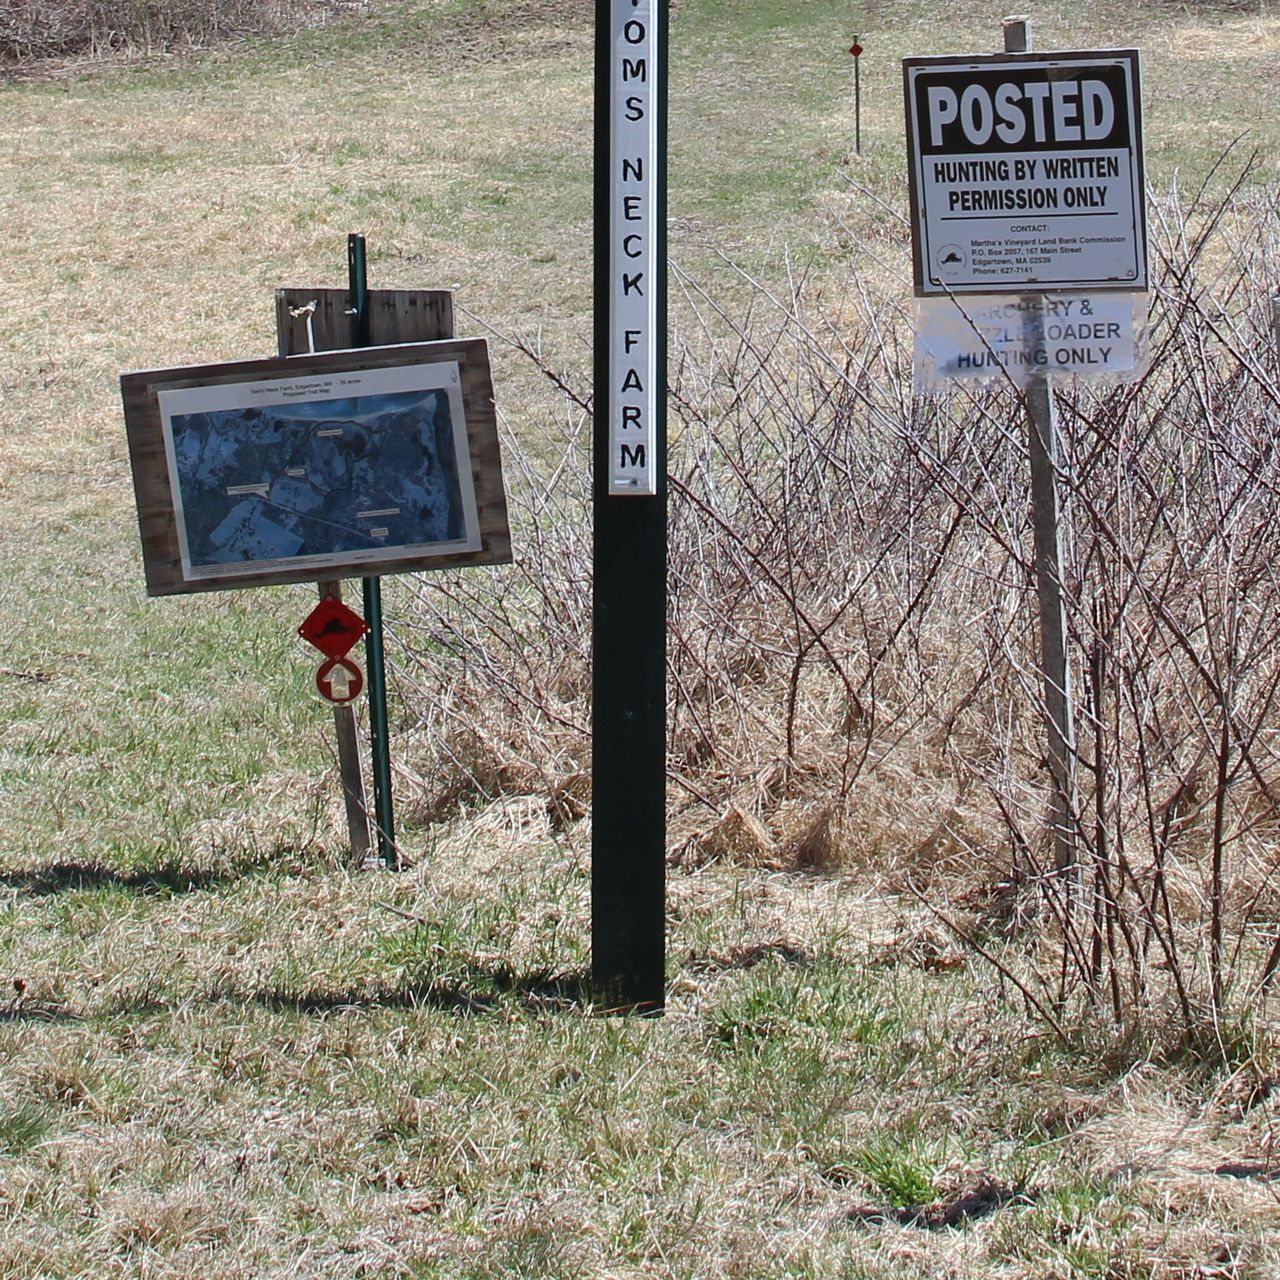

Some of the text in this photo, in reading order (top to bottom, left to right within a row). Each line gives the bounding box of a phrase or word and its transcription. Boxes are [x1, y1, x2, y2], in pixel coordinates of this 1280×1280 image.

[928, 80, 1114, 146] POSTED
[934, 156, 1119, 184] HUNTING BY WRITTEN
[948, 186, 1108, 212] PERMISSION ONLY
[622, 158, 644, 296] NECK
[1010, 224, 1050, 233] CONTACT:
[971, 236, 1126, 247] Martha's Vineyard Land Bank Commission
[988, 248, 1002, 256] Box
[1040, 246, 1058, 254] Main
[1060, 246, 1082, 254] Street
[972, 258, 1014, 267] Edgartown,
[1080, 299, 1094, 316] &
[958, 346, 1112, 368] HUNTING ONLY
[621, 330, 646, 468] FARM
